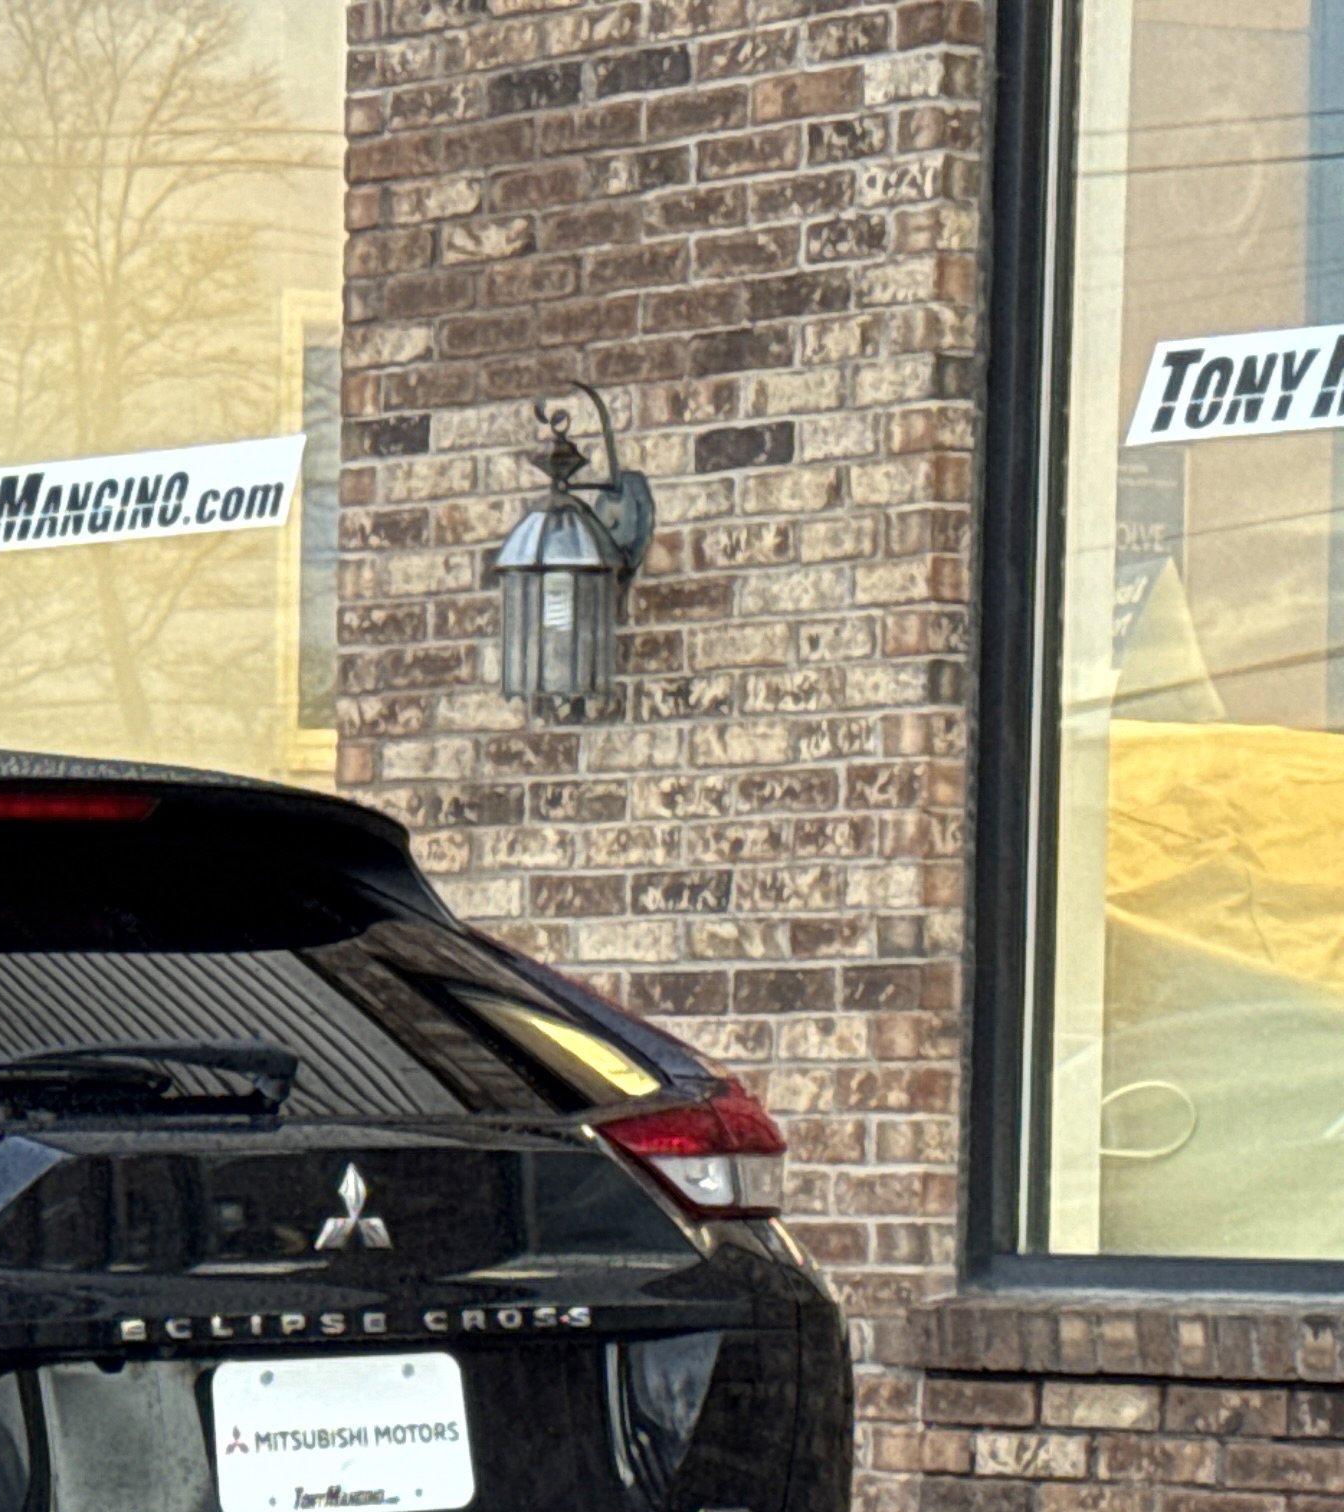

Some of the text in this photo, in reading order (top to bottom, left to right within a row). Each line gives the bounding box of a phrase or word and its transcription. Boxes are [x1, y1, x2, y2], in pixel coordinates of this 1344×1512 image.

[120, 1306, 592, 1342] ECLIPSE CROSS
[254, 1421, 460, 1453] MITSUBISHI MOTORS
